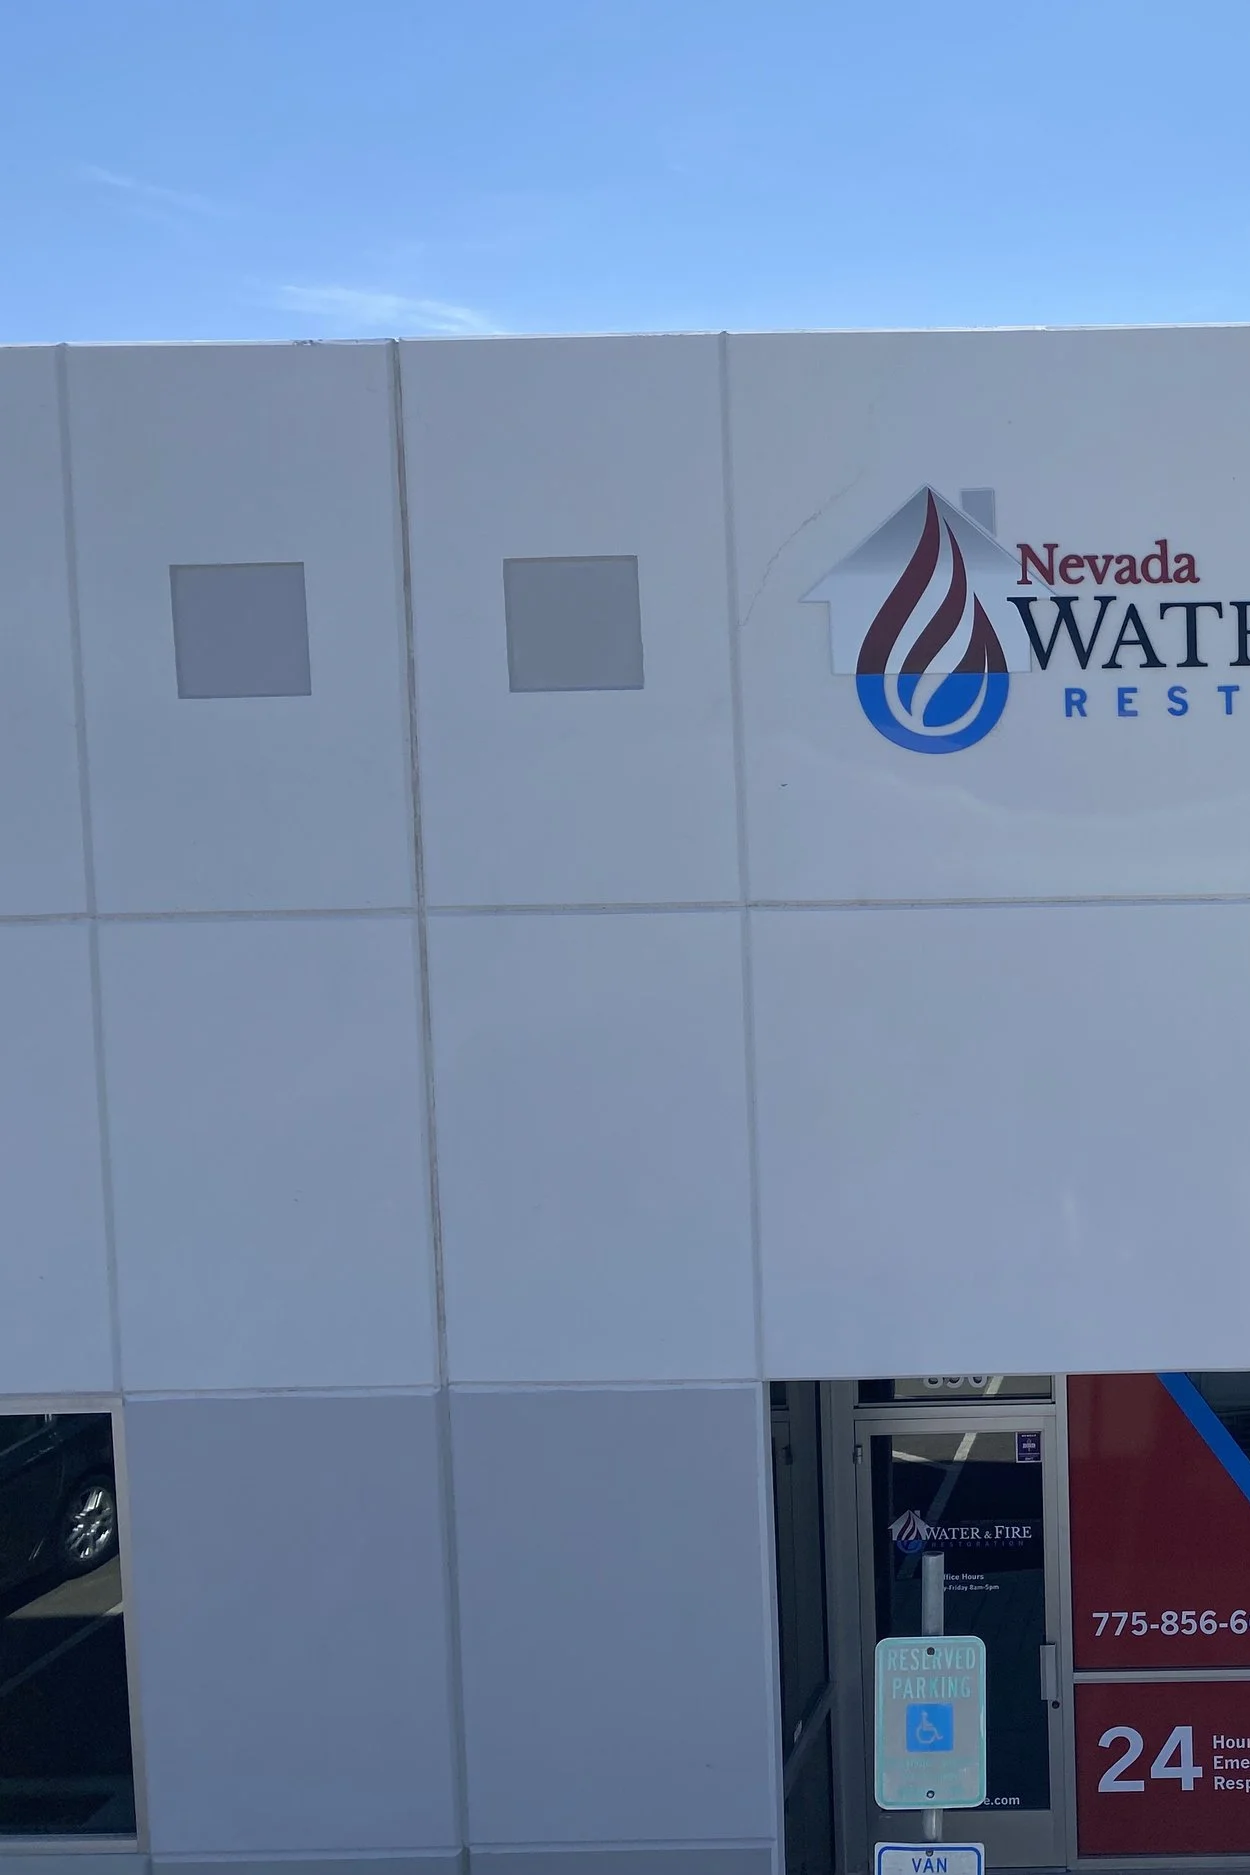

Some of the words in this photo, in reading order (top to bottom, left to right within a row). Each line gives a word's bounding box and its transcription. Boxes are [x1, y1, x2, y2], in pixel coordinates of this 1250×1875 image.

[1015, 540, 1200, 586] Nevada
[925, 1526, 982, 1540] WATER
[984, 1530, 992, 1539] &
[994, 1525, 1032, 1539] FIRE
[931, 1540, 1024, 1548] RESTORATION
[969, 1583, 1000, 1592] 8am-5pm
[887, 1647, 976, 1671] RESERVED
[891, 1675, 972, 1700] PARKING
[1097, 1725, 1203, 1793] 24
[911, 1857, 948, 1873] VAN
